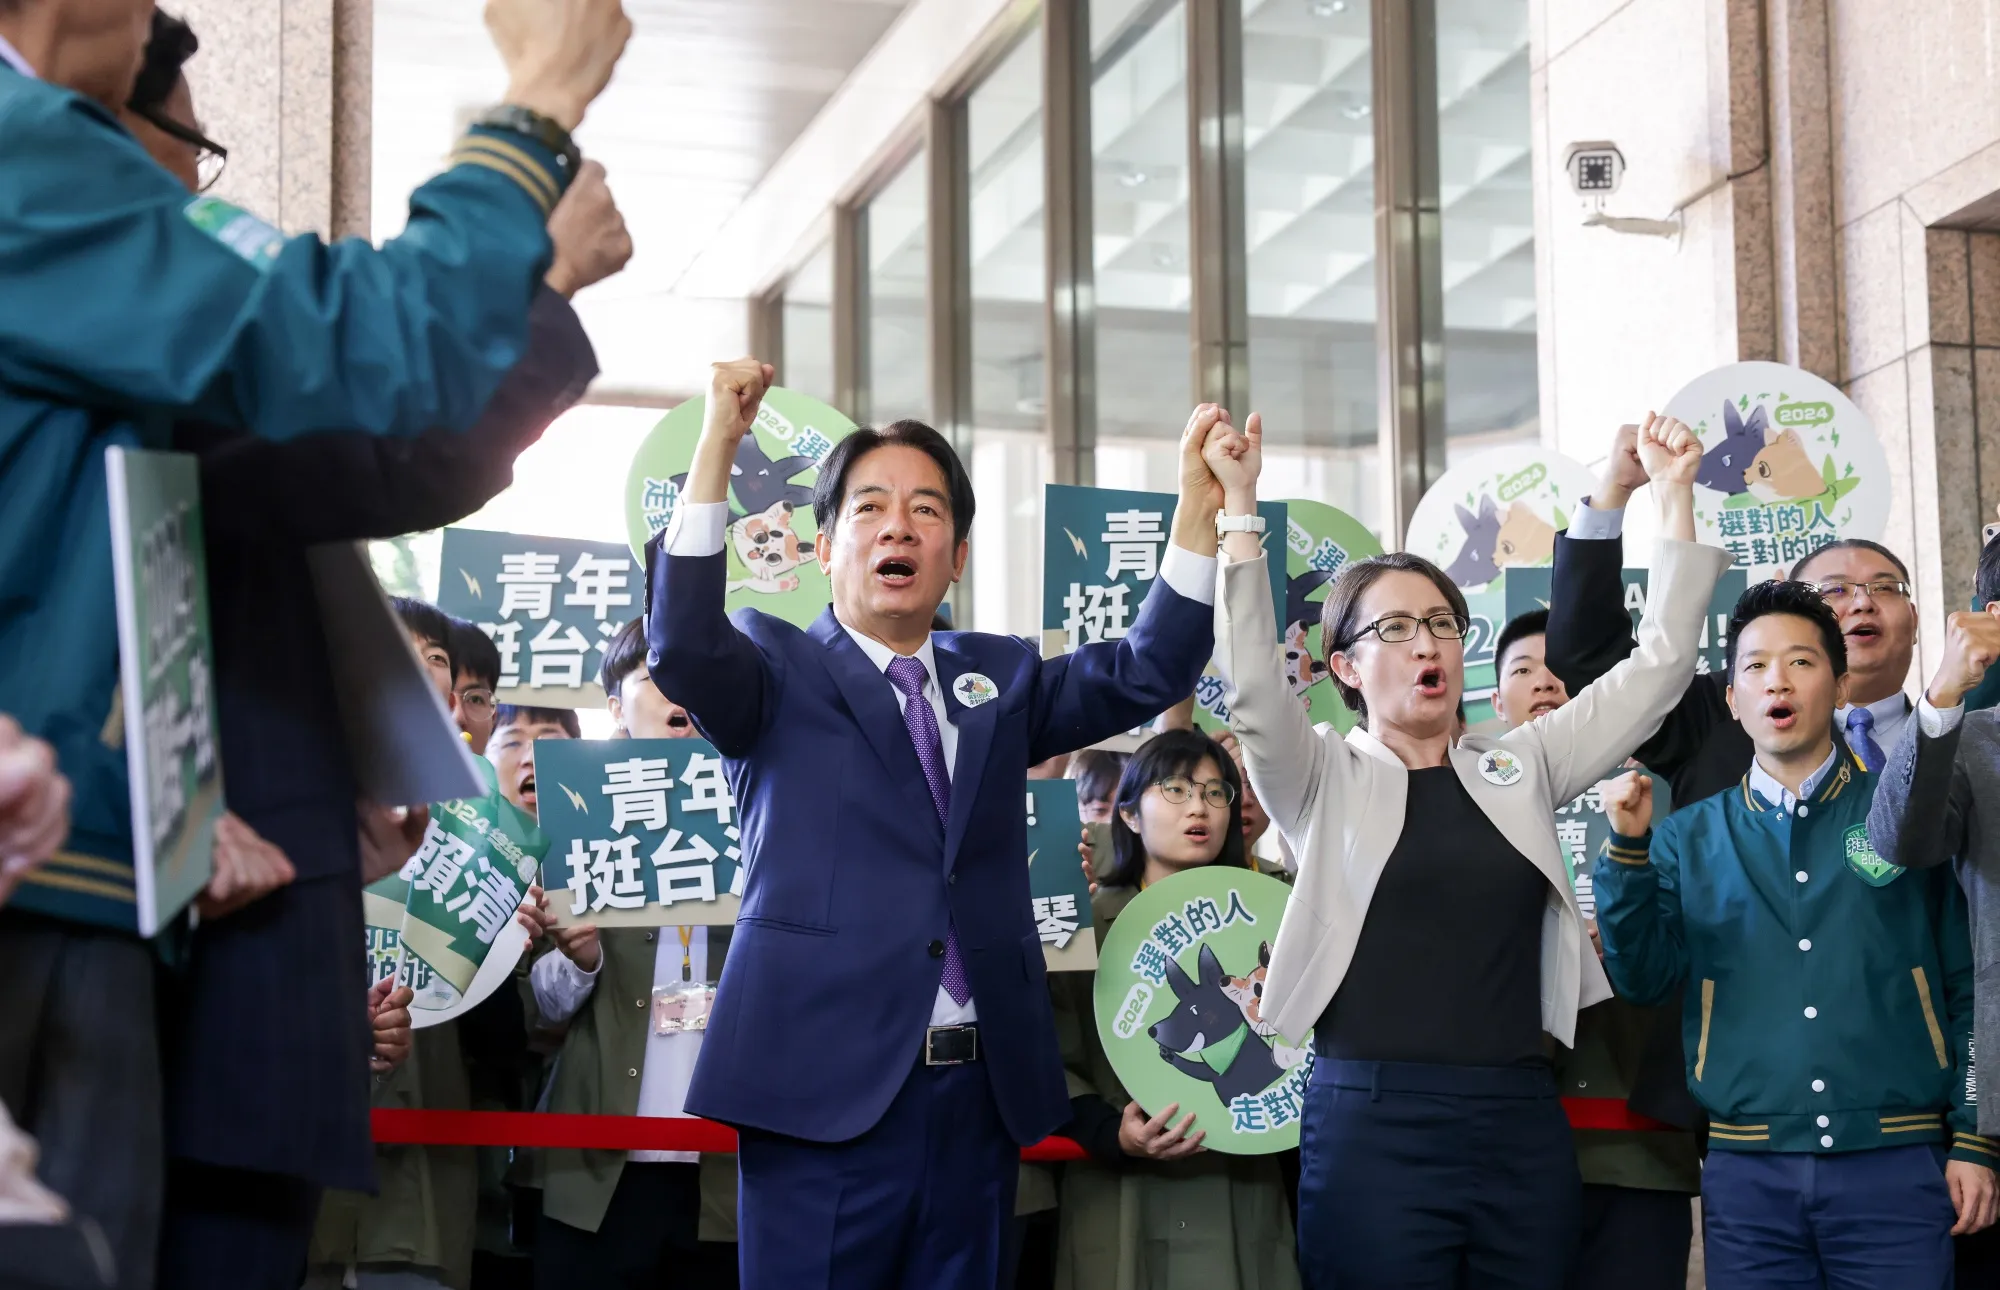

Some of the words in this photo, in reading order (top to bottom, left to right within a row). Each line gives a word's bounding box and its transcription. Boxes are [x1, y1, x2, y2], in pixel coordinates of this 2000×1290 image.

[1780, 407, 1829, 422] 2024
[1502, 467, 1542, 499] 2024
[1101, 509, 1165, 581] 青
[1717, 502, 1836, 537] 選對的人
[496, 551, 632, 620] 青年
[1062, 583, 1134, 652] 挺
[602, 753, 738, 833] 青年
[565, 827, 743, 916] 挺台
[1861, 853, 1891, 866] 202
[1032, 894, 1079, 949] 琴
[1133, 892, 1256, 985] 選對的人
[1117, 987, 1149, 1036] 2024
